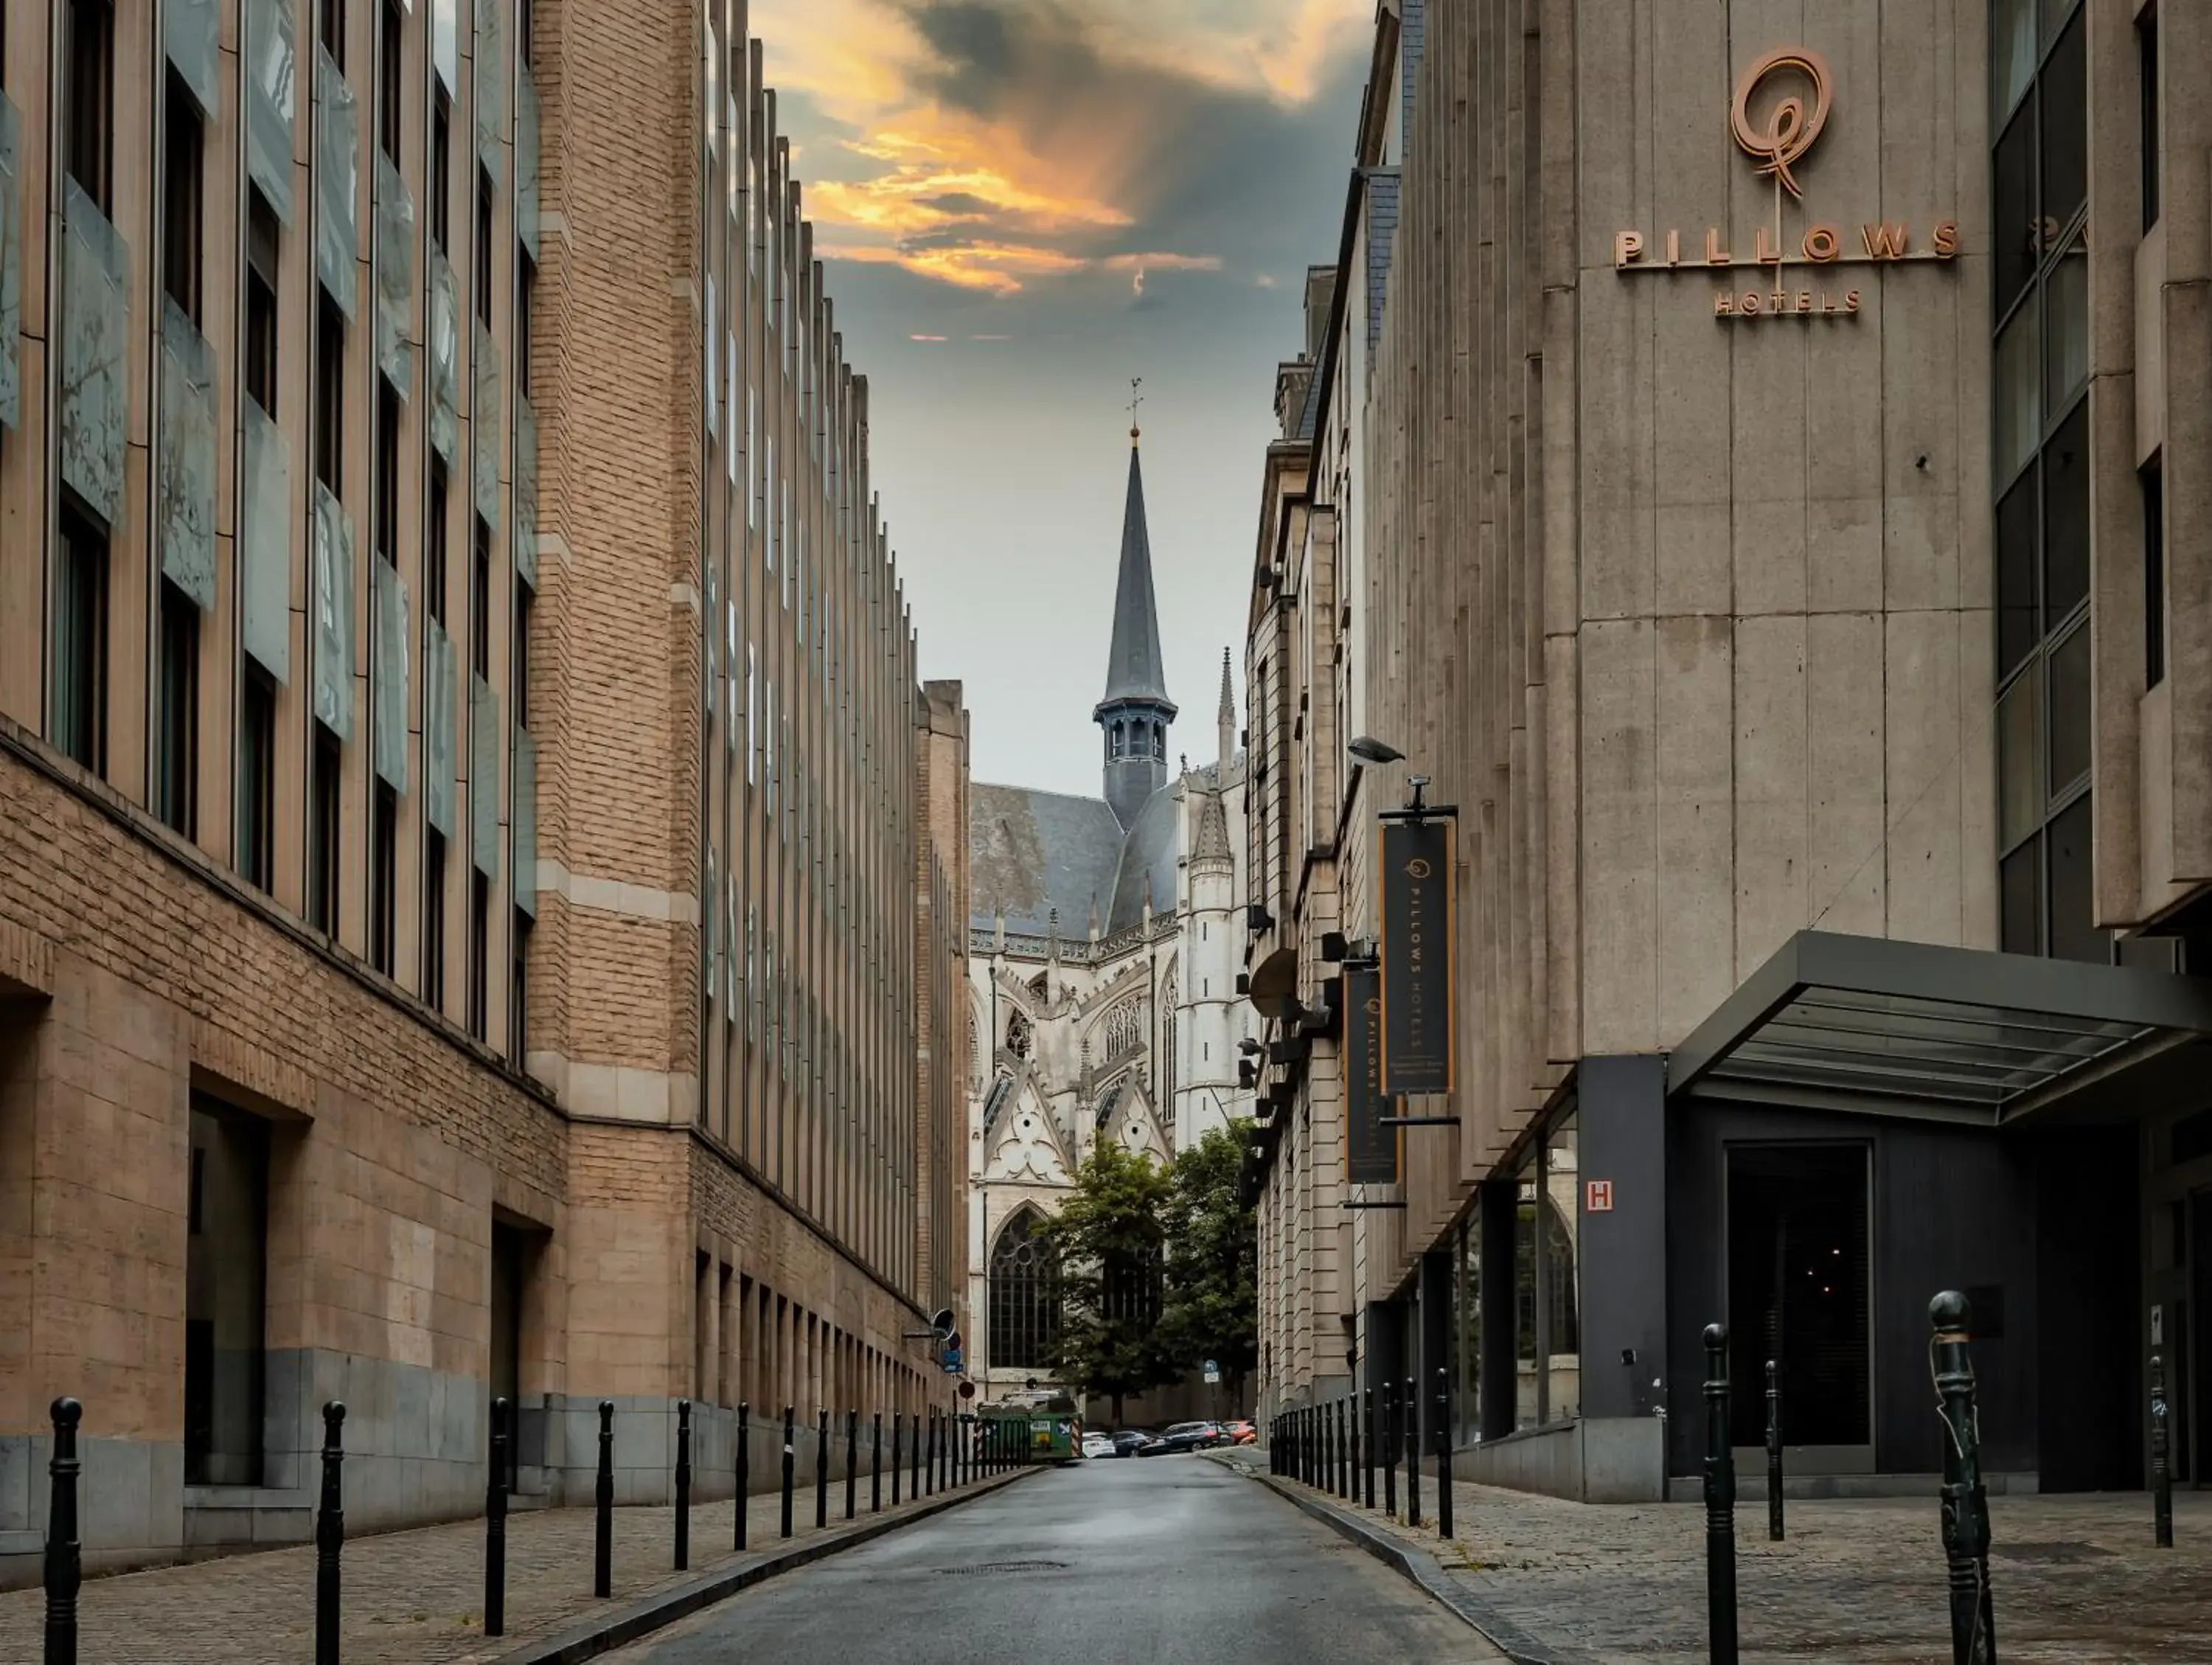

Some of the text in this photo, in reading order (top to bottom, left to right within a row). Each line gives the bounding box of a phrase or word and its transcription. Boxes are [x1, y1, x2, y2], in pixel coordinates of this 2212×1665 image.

[1616, 222, 1958, 268] PILLOWS
[1714, 290, 1860, 315] HOTELS
[1409, 887, 1422, 1048] PILLOWS HOTELS
[1591, 1183, 1608, 1208] H
